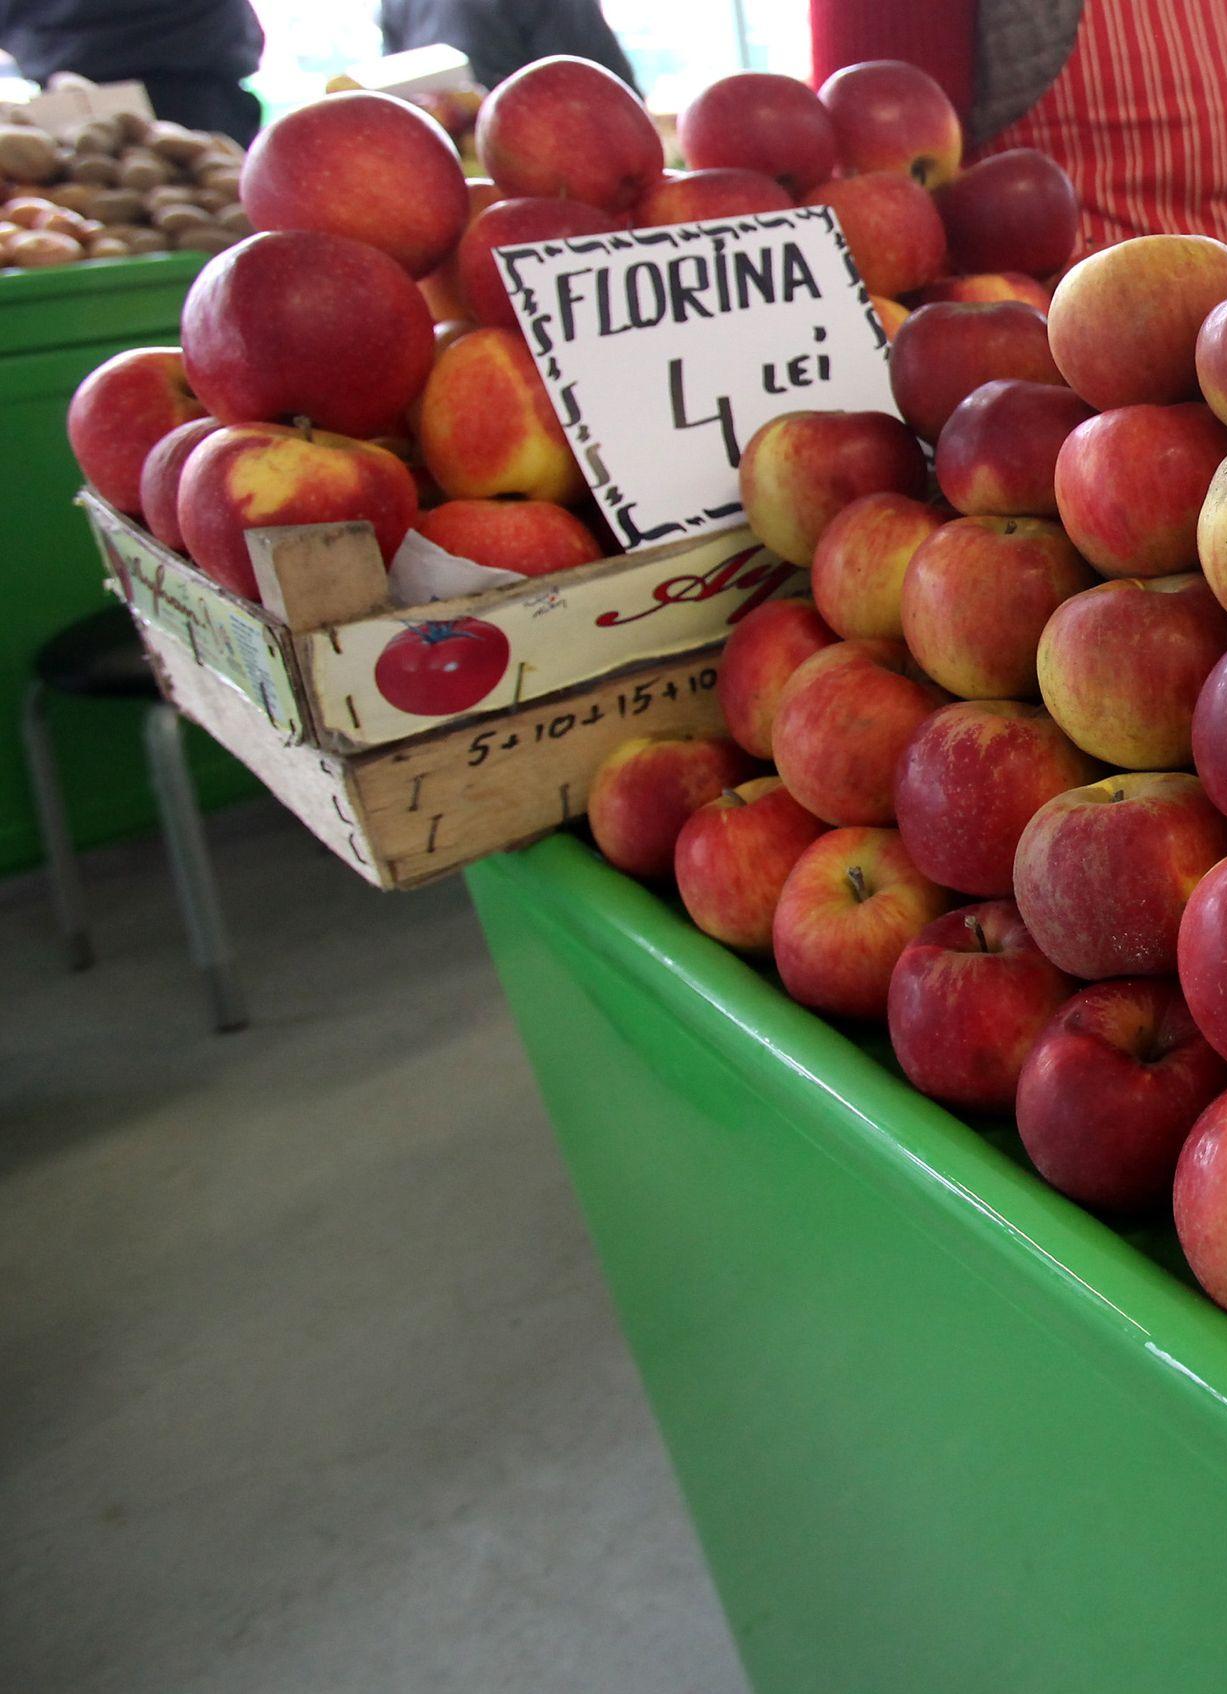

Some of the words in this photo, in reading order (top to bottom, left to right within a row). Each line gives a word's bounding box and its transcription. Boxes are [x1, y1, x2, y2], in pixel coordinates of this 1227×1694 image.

[556, 238, 822, 342] FLORINA
[668, 358, 741, 469] 4
[762, 327, 831, 394] LEI
